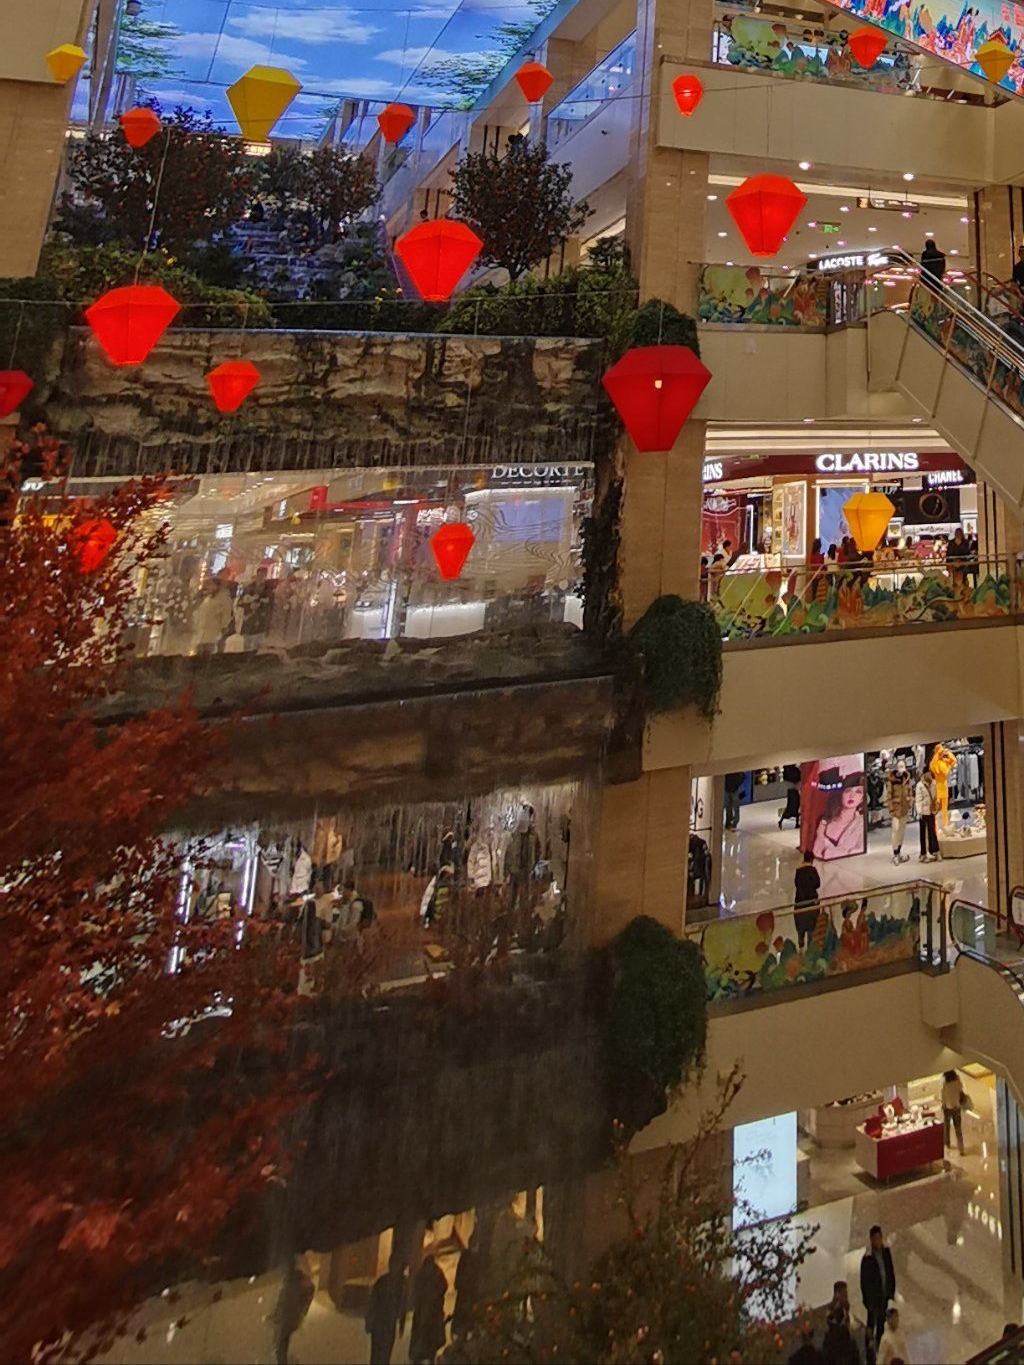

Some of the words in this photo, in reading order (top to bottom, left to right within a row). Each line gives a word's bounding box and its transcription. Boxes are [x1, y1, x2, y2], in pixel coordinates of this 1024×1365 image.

[819, 256, 864, 271] LACOSTE
[815, 452, 919, 472] CLARINS
[928, 470, 964, 484] CHANEL
